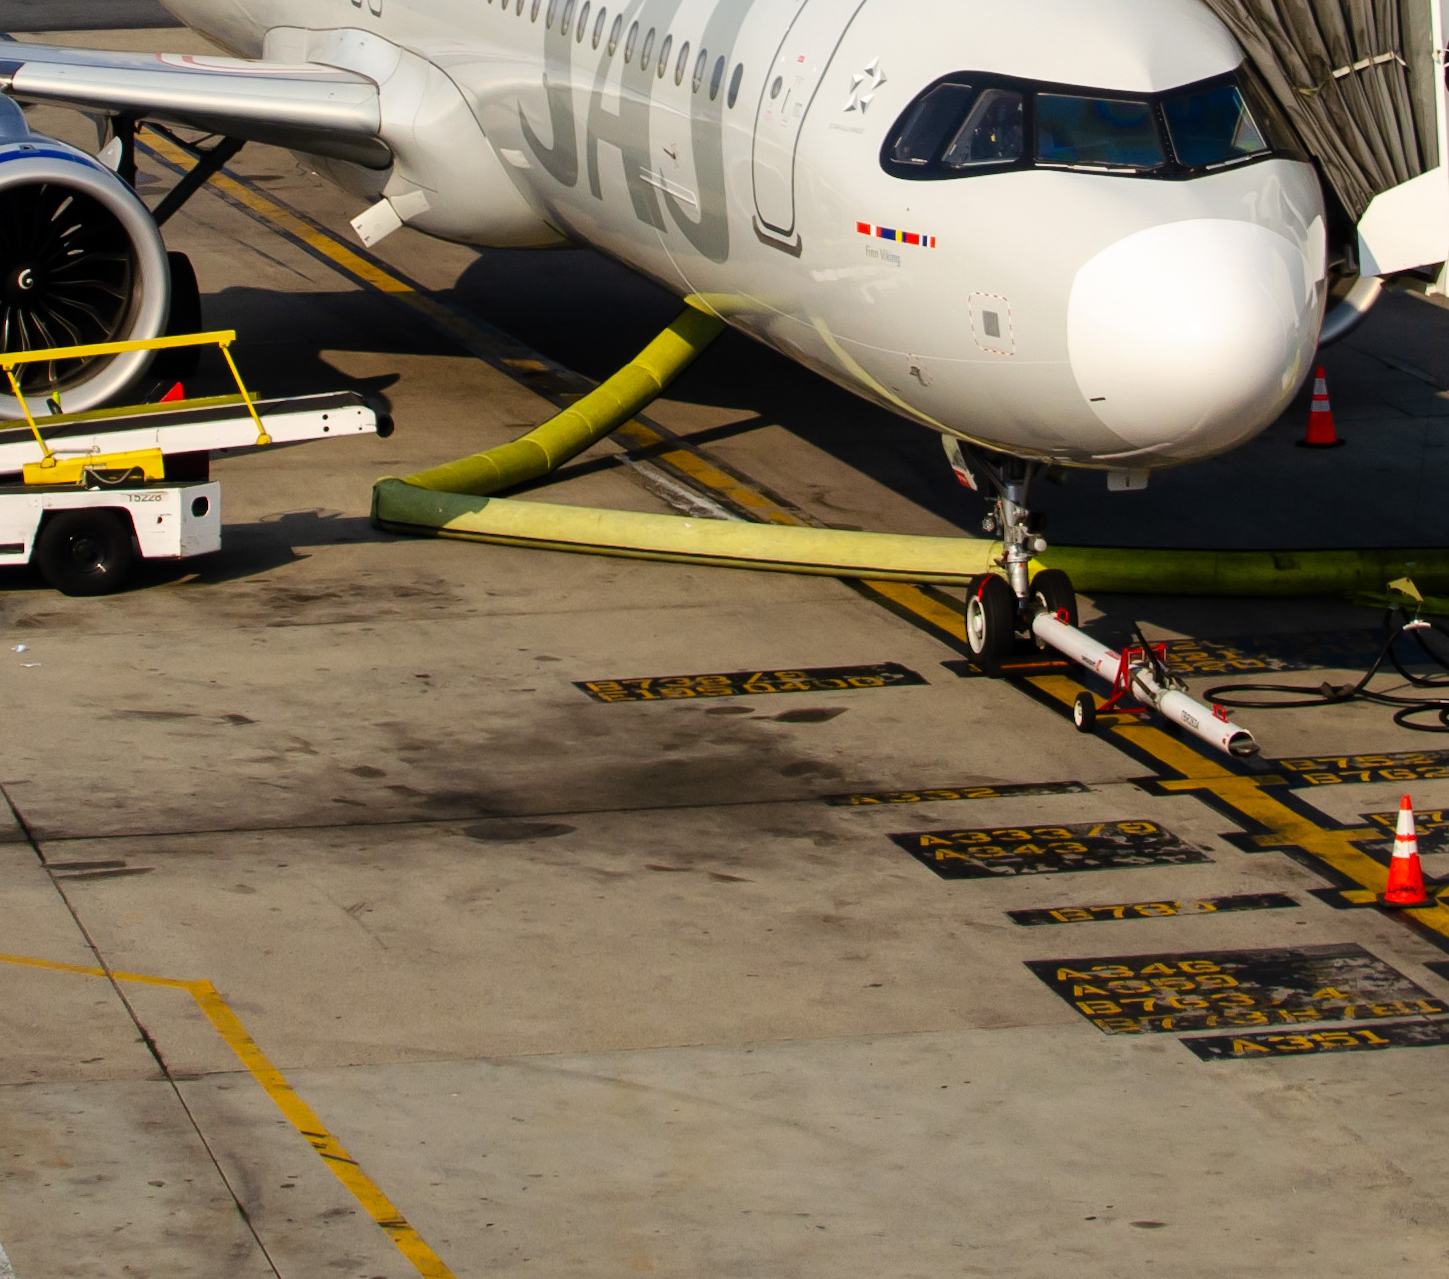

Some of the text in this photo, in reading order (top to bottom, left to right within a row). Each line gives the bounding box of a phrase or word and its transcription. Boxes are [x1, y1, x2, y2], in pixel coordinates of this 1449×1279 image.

[934, 841, 1089, 861] A343
[1056, 960, 1221, 981] A346
[1232, 1029, 1391, 1054] A351
